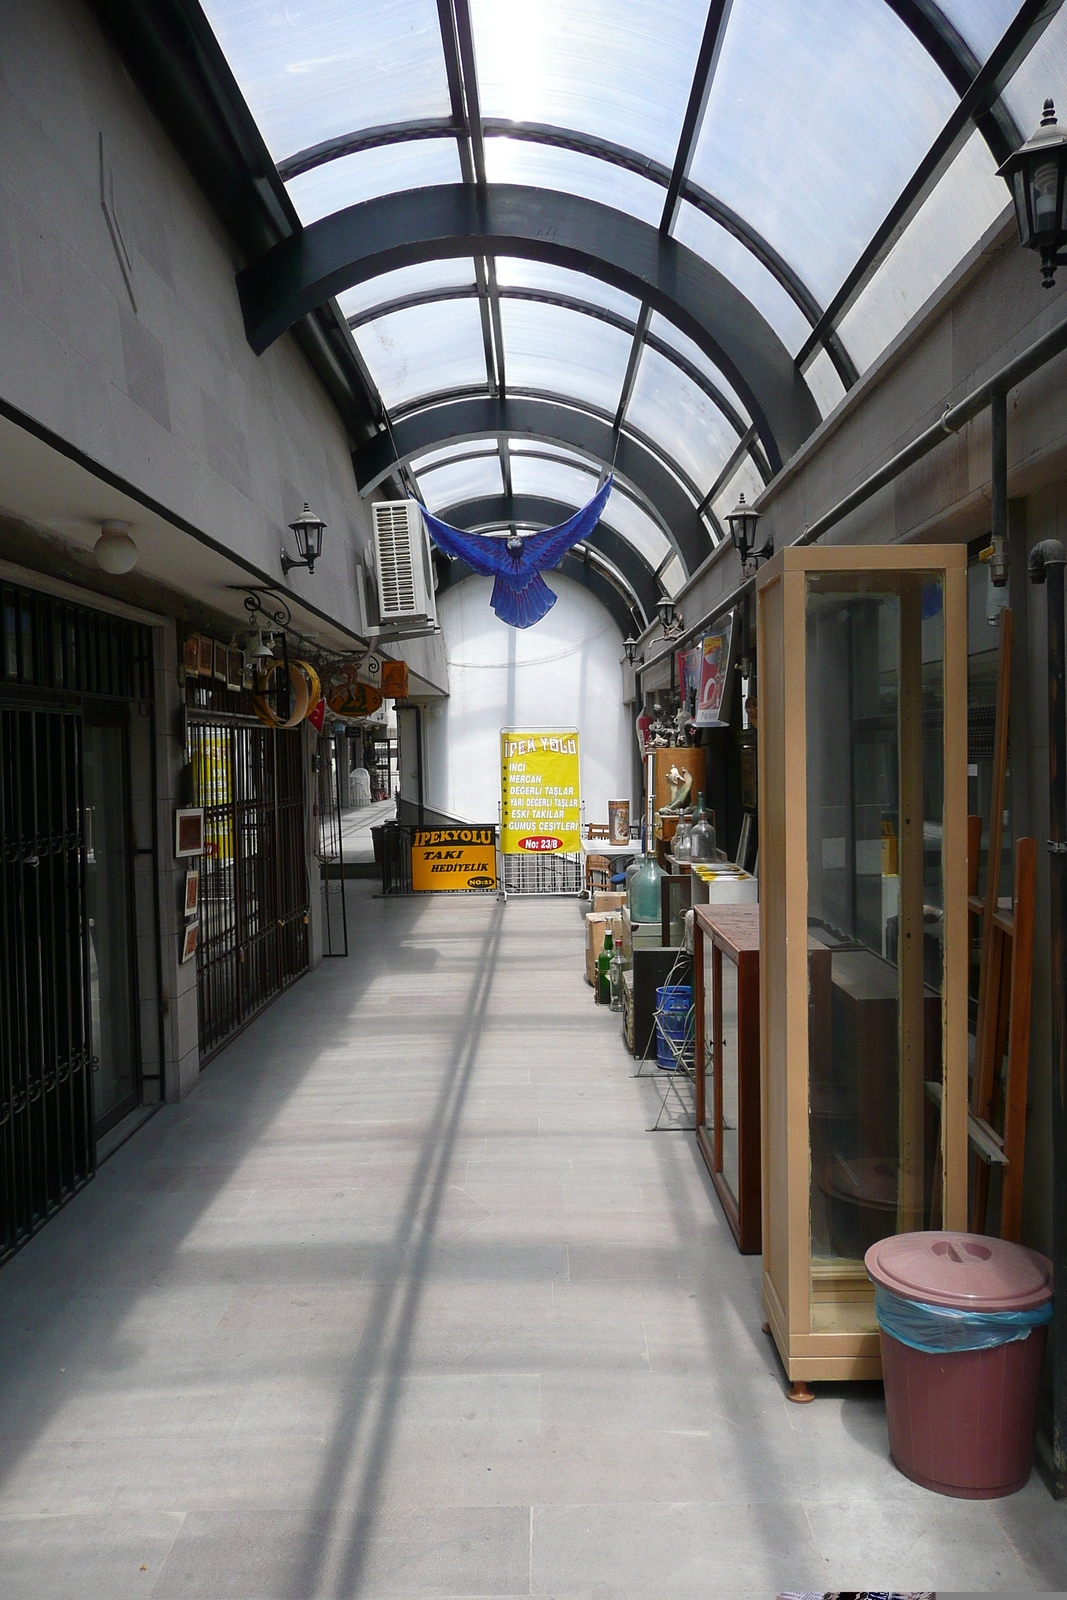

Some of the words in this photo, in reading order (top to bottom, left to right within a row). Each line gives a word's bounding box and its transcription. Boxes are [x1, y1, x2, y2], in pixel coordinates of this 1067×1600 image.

[504, 739, 536, 758] İPEK
[540, 737, 577, 755] YOLU
[509, 761, 526, 772] İNCİ
[509, 775, 541, 784] MERCAN
[510, 785, 542, 795] DEĞERLİ
[545, 786, 574, 798] TAŞLAR
[510, 797, 524, 807] YARI
[526, 796, 553, 807] DEĞERLİ
[554, 798, 578, 809] TAŞLAR
[511, 809, 530, 819] ESKİ
[532, 809, 564, 819] TAKILAR
[508, 819, 537, 833] GÜMÜŞ
[538, 820, 578, 833] ÇEŞİTLERİ
[413, 829, 492, 846] İPEKYOLU
[525, 839, 539, 849] No:
[423, 850, 464, 861] TAKI
[431, 862, 489, 873] HEDİYELİK
